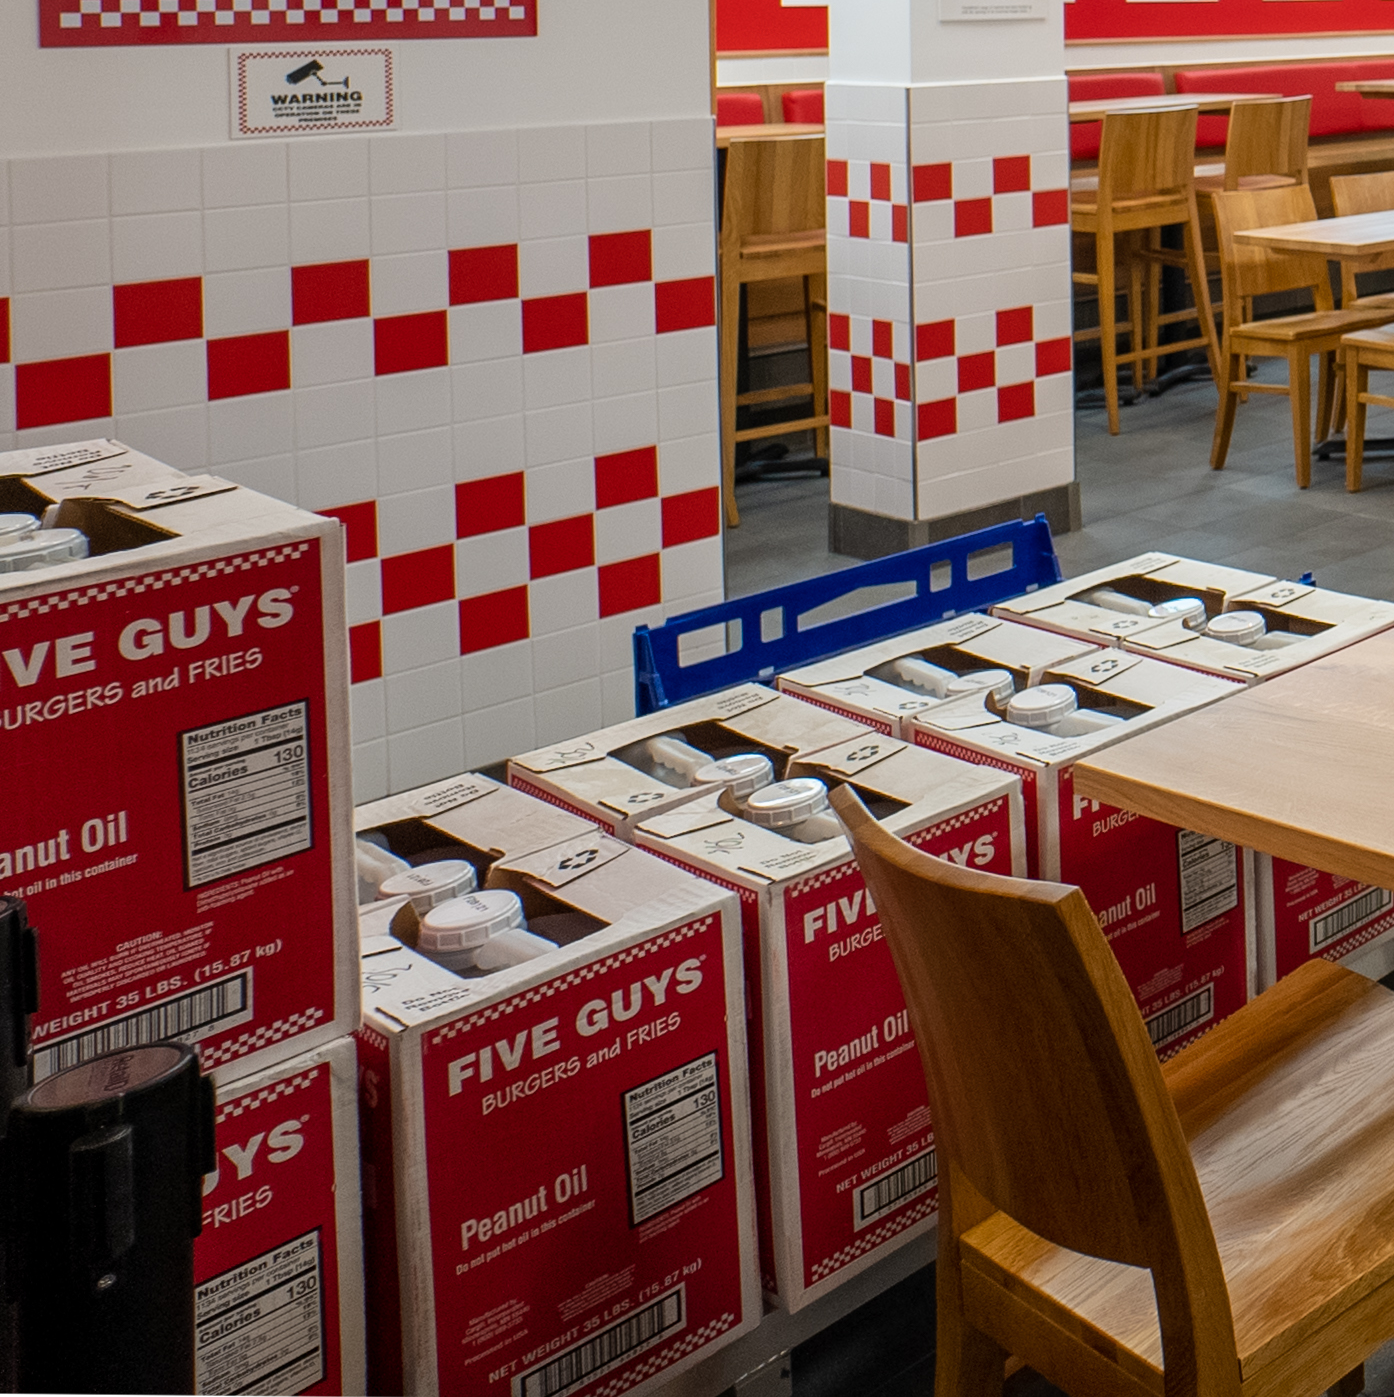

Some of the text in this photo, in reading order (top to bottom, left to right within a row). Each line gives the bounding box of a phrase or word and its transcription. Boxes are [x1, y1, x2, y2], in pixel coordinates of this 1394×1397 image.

[271, 91, 363, 105] WARNING
[131, 668, 180, 699] and
[188, 647, 263, 684] FRIES
[188, 707, 303, 745] Nutrition Facts
[187, 750, 219, 764] Serving
[222, 744, 239, 755] size
[188, 744, 304, 789] Calories 130
[81, 810, 128, 853] Oil
[938, 834, 995, 866] YS
[26, 853, 138, 896] oil in this container
[1135, 882, 1156, 911] Oil
[1298, 893, 1344, 923] NET WEIGHT
[115, 930, 163, 952] CAUTION:
[828, 923, 886, 963] BURGE
[115, 992, 139, 1010] 35
[145, 975, 188, 998] LBS.
[193, 949, 251, 982] (15.87
[255, 938, 283, 958] kg)
[447, 1016, 560, 1097] FIVE
[482, 1011, 681, 1116] BURGERS and FRIES
[814, 1008, 909, 1078] Peanut Oil
[629, 1058, 713, 1103] Nutrition Facts
[810, 1088, 821, 1098] Do
[631, 1090, 716, 1140] Calories 130
[836, 1140, 919, 1194] NET WEIGHT 35
[460, 1185, 549, 1251] Peanut
[554, 1164, 588, 1204] Oil
[455, 1199, 596, 1276] Do not put hot oil in this container
[197, 1238, 314, 1300] Nutrition Facts
[197, 1300, 230, 1320] Serving
[273, 1268, 294, 1283] Tbsp
[199, 1275, 317, 1344] Calories 130
[488, 1257, 702, 1384] NET WEIGHT 35 LBS. (15.87 kg)
